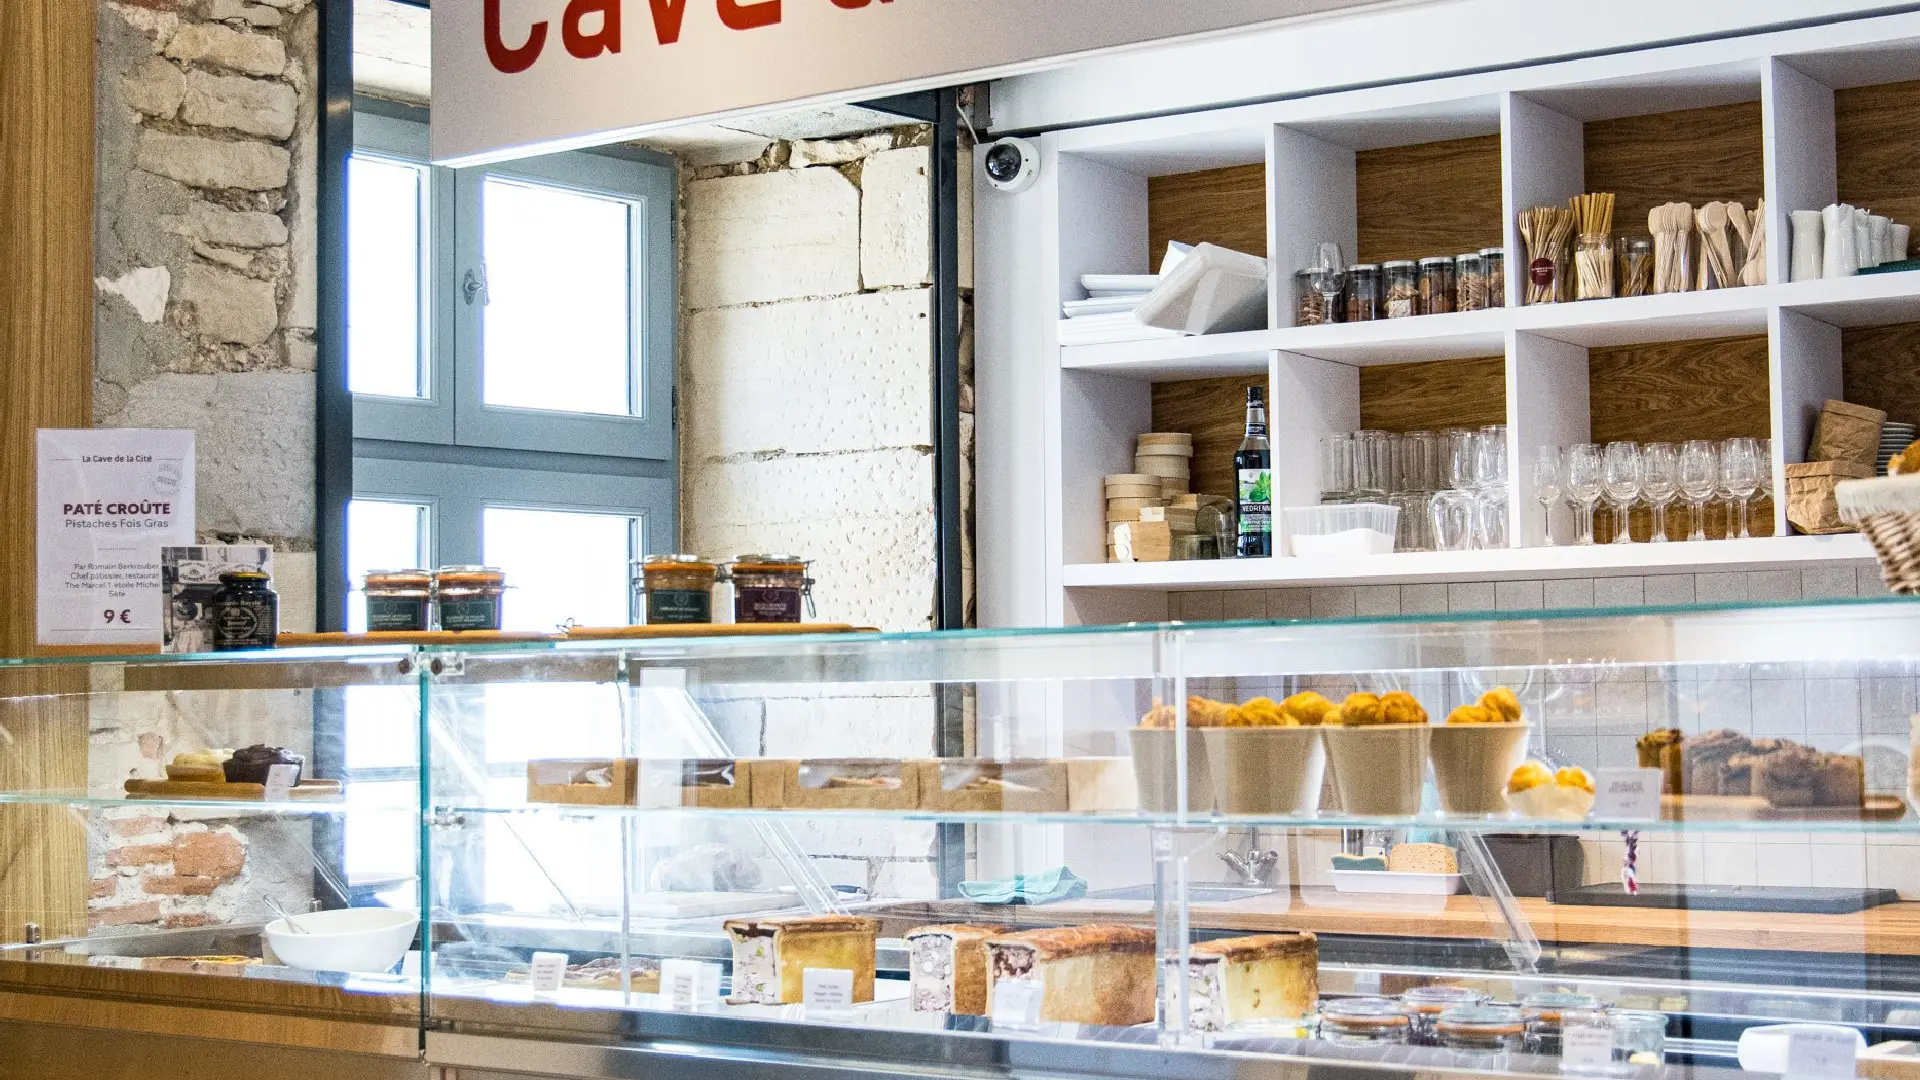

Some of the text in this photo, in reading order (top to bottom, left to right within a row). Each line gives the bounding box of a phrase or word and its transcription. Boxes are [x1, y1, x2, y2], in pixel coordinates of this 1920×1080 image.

[82, 454, 153, 463] La Cave de la Cité
[63, 499, 171, 515] PATÉ CROÛTE
[1242, 504, 1271, 512] VEDRENN
[65, 519, 169, 528] Pistaches Fois Gras
[70, 572, 89, 580] Chef
[81, 581, 106, 589] Marcel
[103, 609, 131, 624] 9 €
